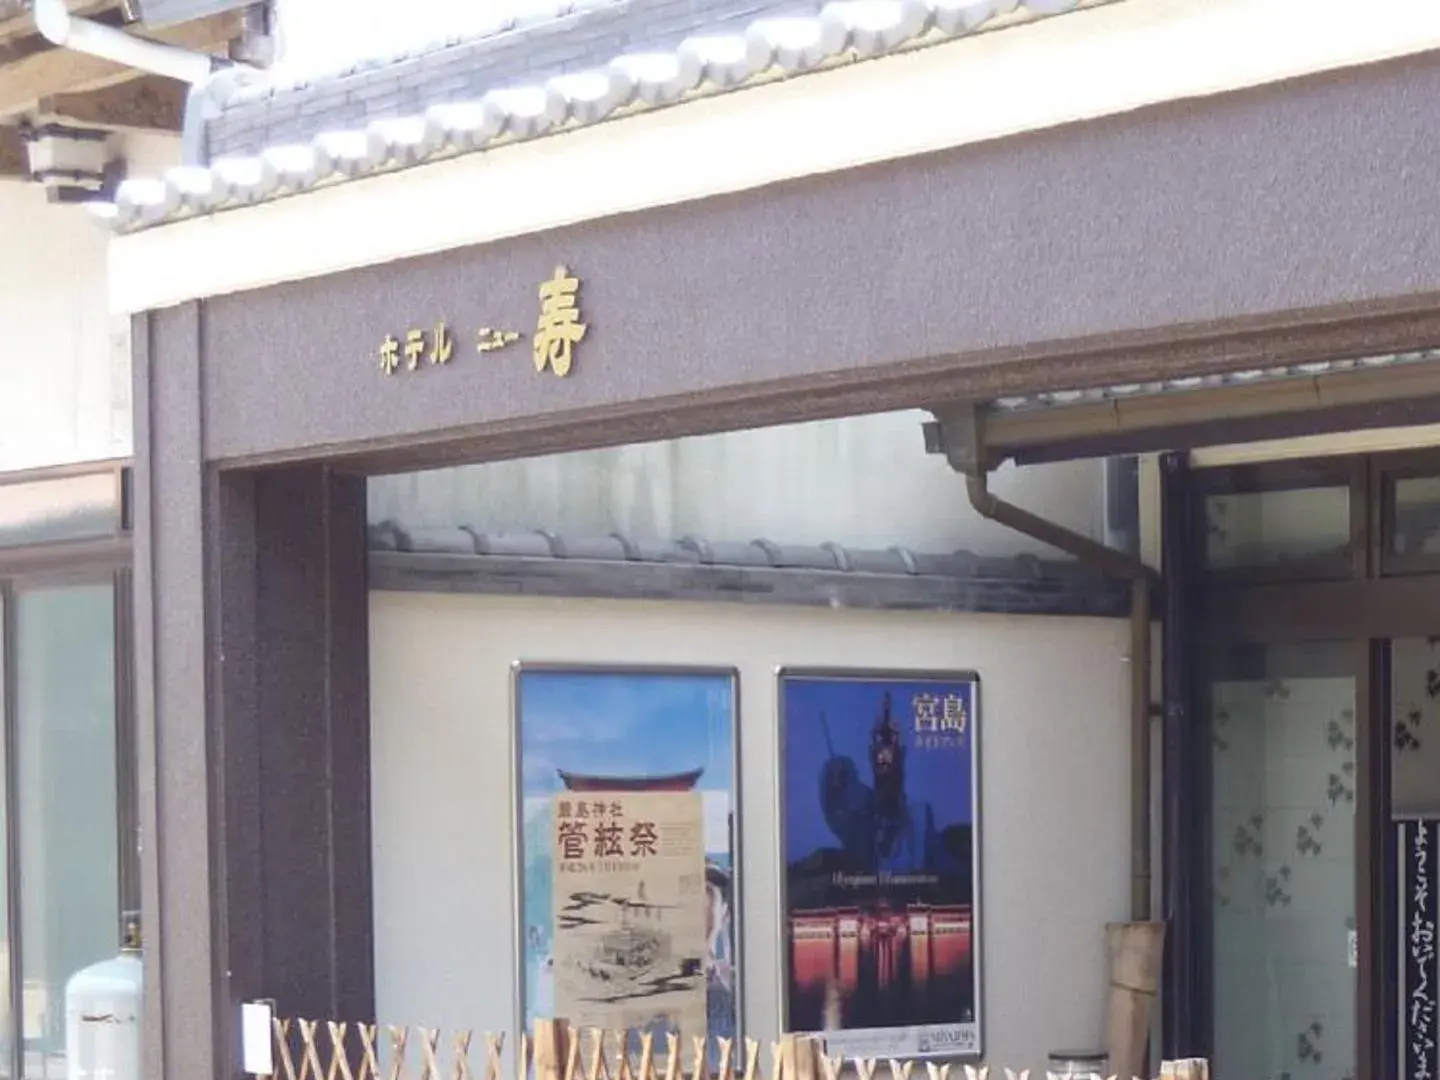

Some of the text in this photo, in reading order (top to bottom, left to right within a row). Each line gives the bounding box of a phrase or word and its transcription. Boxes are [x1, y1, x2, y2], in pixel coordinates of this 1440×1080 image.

[379, 264, 587, 377] ホテル ニュー 寿
[912, 692, 967, 733] 宮島
